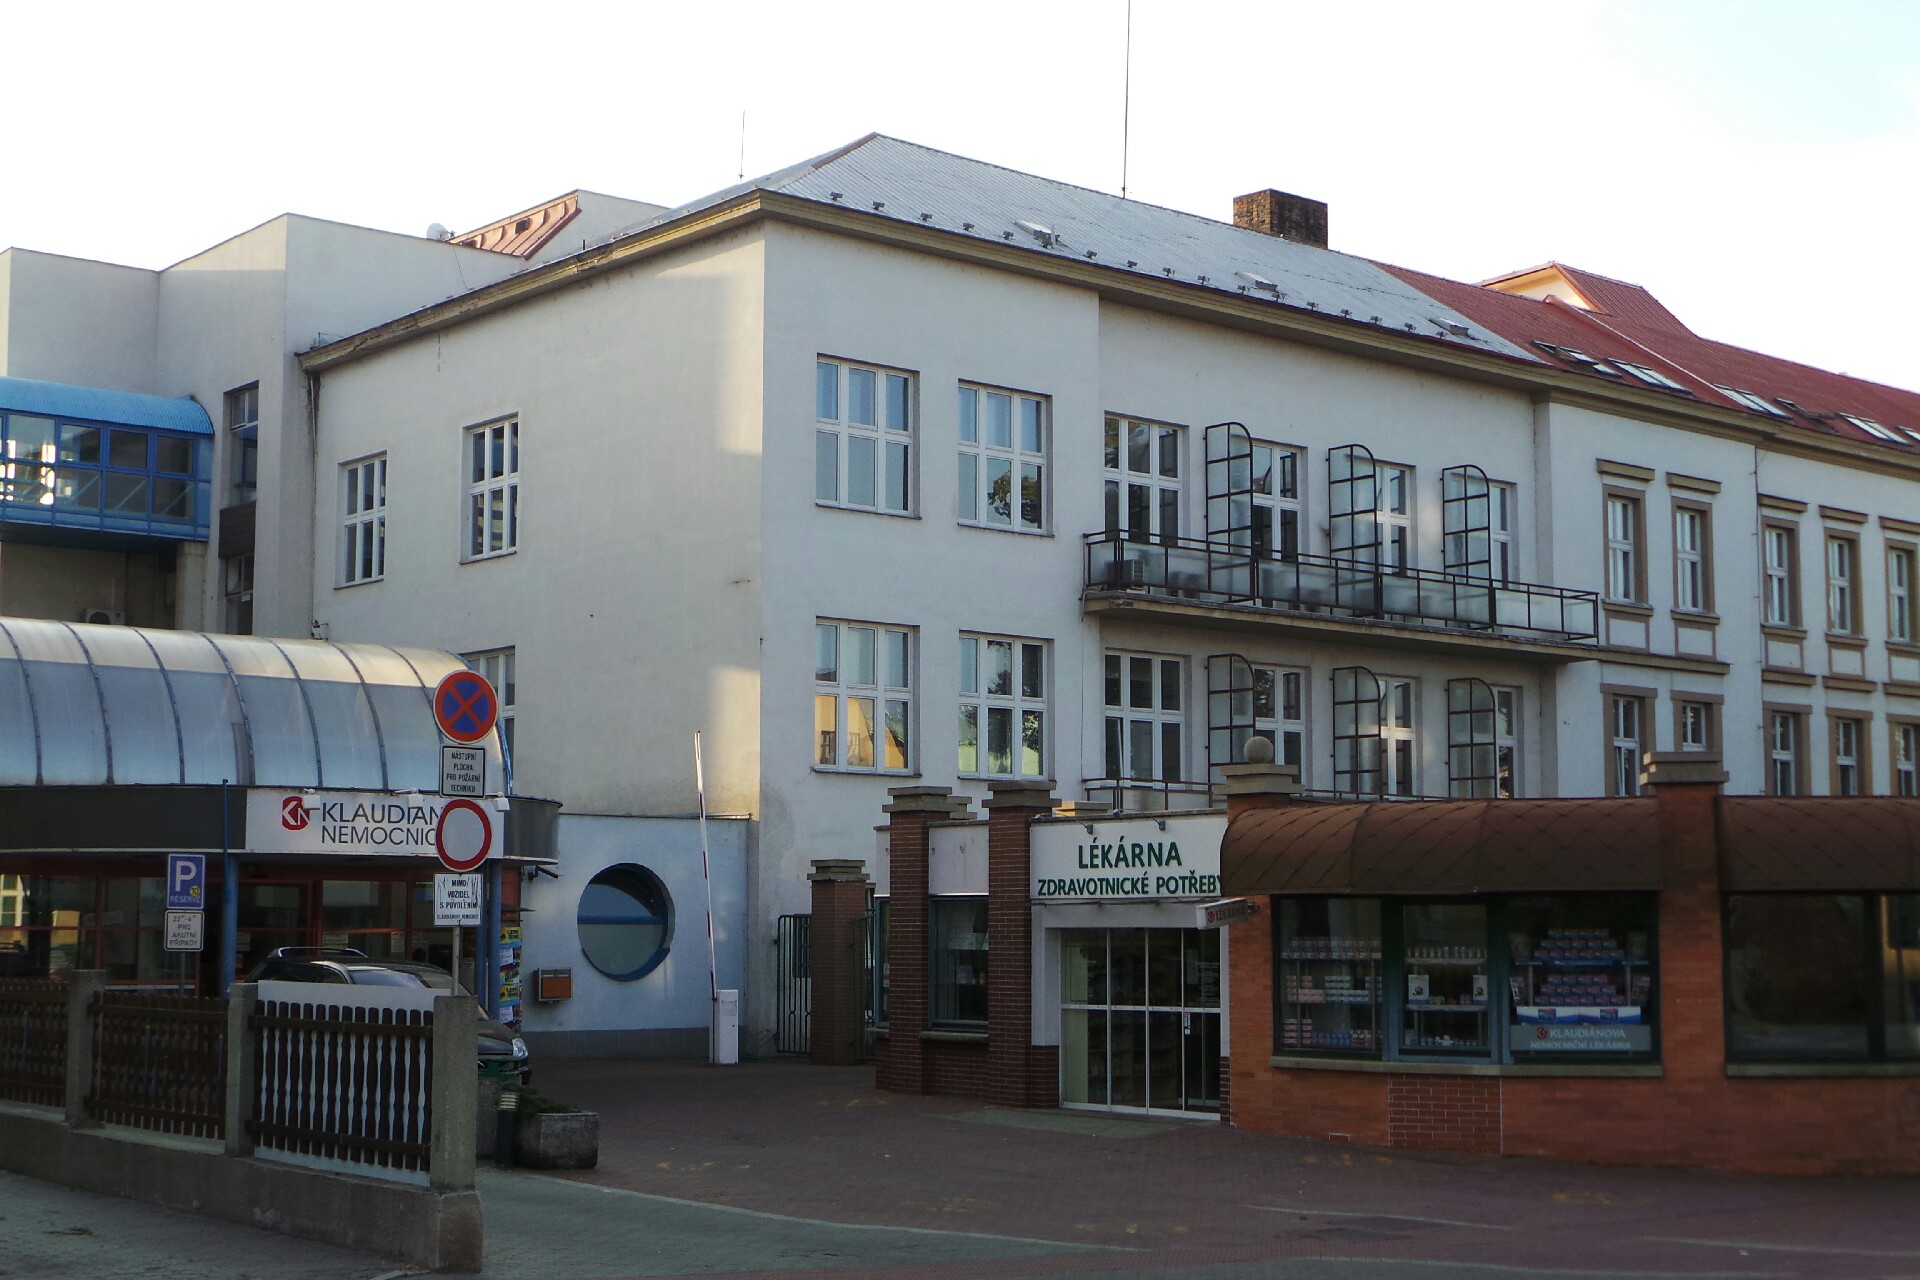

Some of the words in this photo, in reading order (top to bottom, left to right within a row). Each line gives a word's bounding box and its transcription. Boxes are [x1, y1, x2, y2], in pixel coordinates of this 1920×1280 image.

[453, 762, 474, 771] PLOCHA
[446, 773, 457, 781] PRO
[450, 784, 476, 793] TECHNIKU
[1078, 836, 1183, 869] LÉKÁRNA
[175, 860, 197, 892] P
[451, 879, 467, 887] MIMO
[1037, 871, 1149, 896] ZDRAVOTNICKÉ
[447, 890, 471, 899] VOZIDEL
[439, 901, 445, 909] S
[177, 923, 192, 931] PRO
